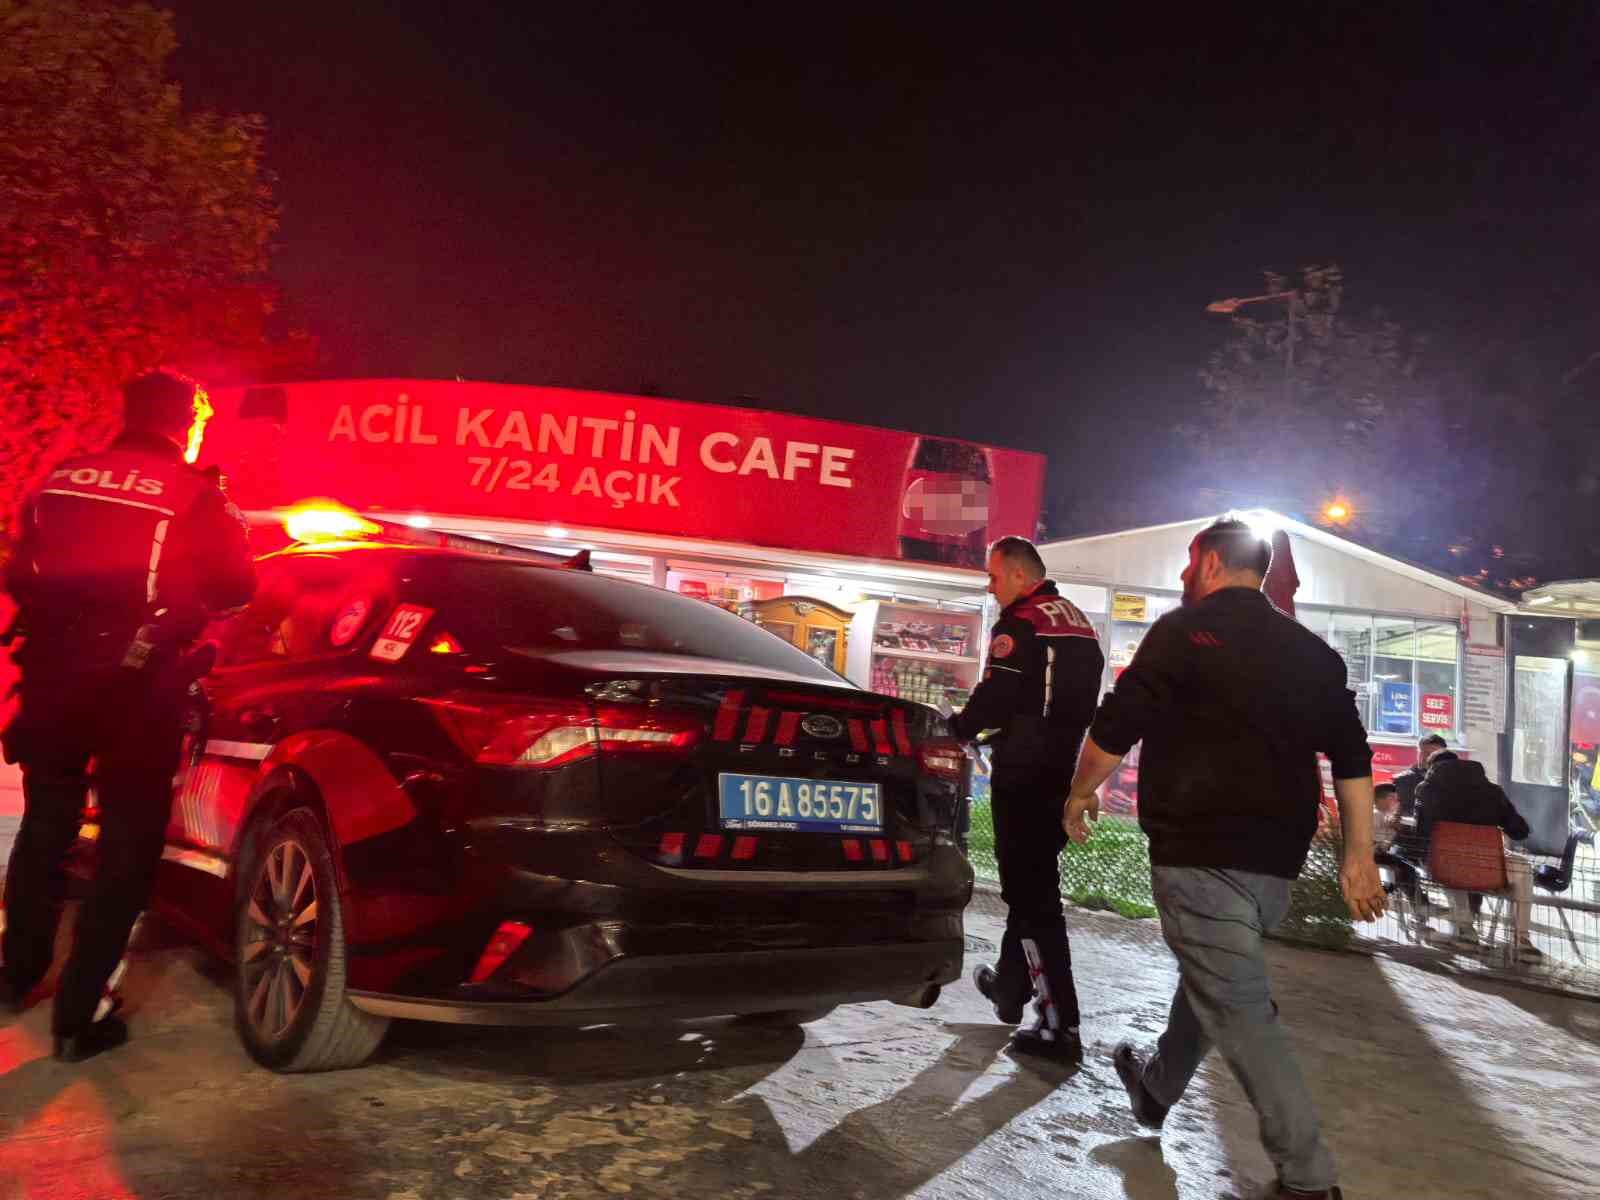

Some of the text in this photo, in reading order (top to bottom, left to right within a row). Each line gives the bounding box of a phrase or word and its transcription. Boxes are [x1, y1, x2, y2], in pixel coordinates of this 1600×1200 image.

[328, 393, 855, 489] ACİL KANTİN CAFE
[467, 456, 681, 508] 7/24 AÇIK
[388, 609, 422, 638] 112
